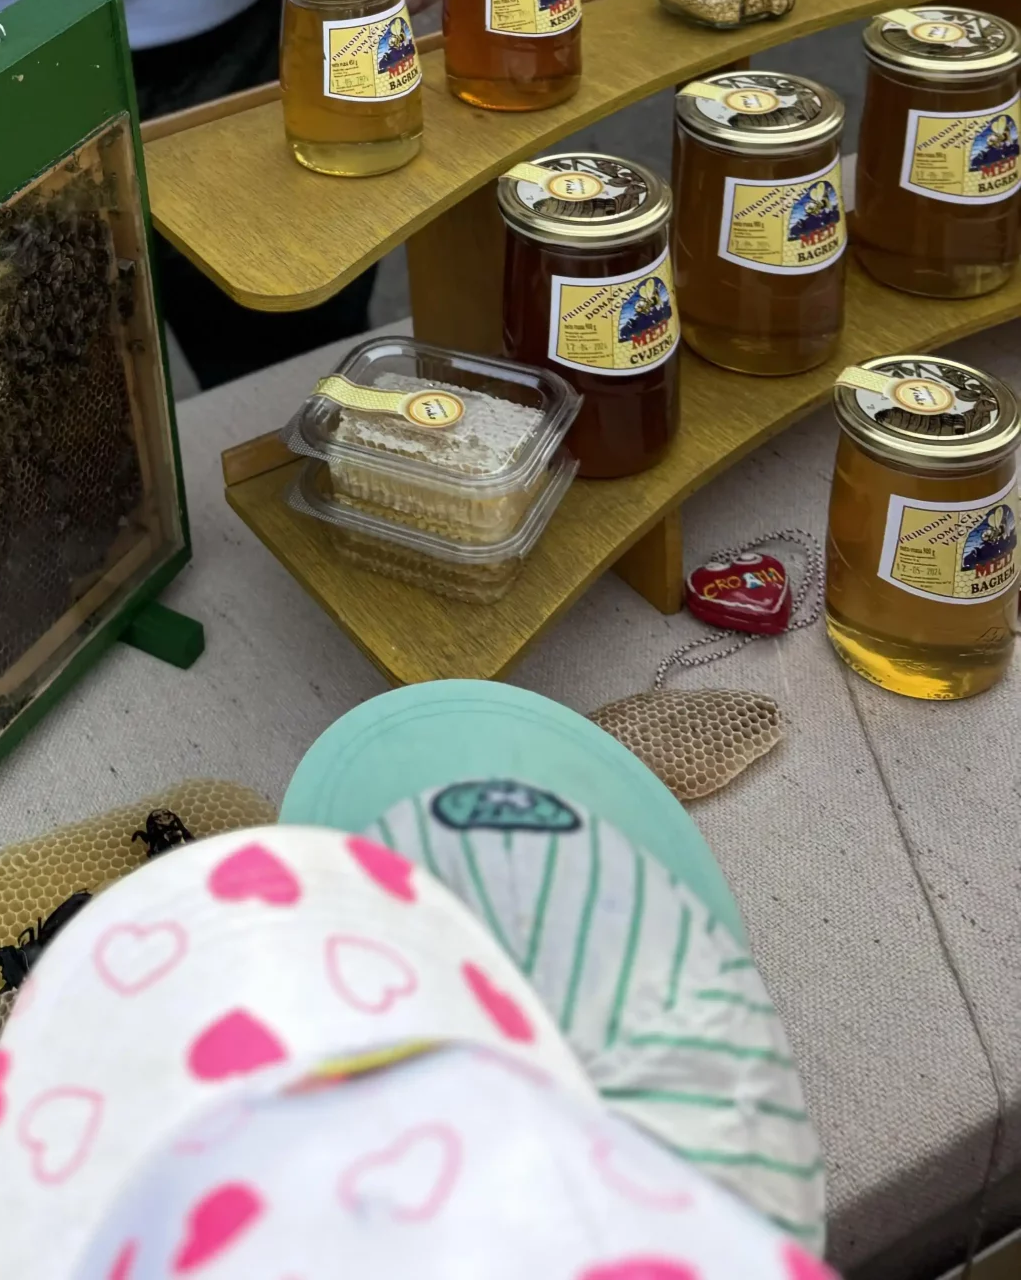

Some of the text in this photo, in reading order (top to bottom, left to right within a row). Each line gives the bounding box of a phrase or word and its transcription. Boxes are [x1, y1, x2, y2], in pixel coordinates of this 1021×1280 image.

[549, 7, 578, 27] KESTEN
[331, 27, 367, 61] PRIRODNI
[387, 55, 414, 79] MED
[389, 66, 419, 90] BAGREM
[917, 120, 963, 151] PRIRODNI
[981, 155, 1016, 180] MED
[734, 188, 780, 220] PRIRODNI
[798, 237, 839, 262] BAGREM
[799, 222, 836, 249] MED
[561, 287, 608, 322] PRIRODNI
[630, 334, 673, 365] CVJETNI
[631, 320, 668, 350] MED
[899, 513, 952, 544] PRIRODNI
[971, 563, 1015, 594] BAGREM
[974, 550, 1014, 579] MED
[703, 567, 784, 599] CROATIA
